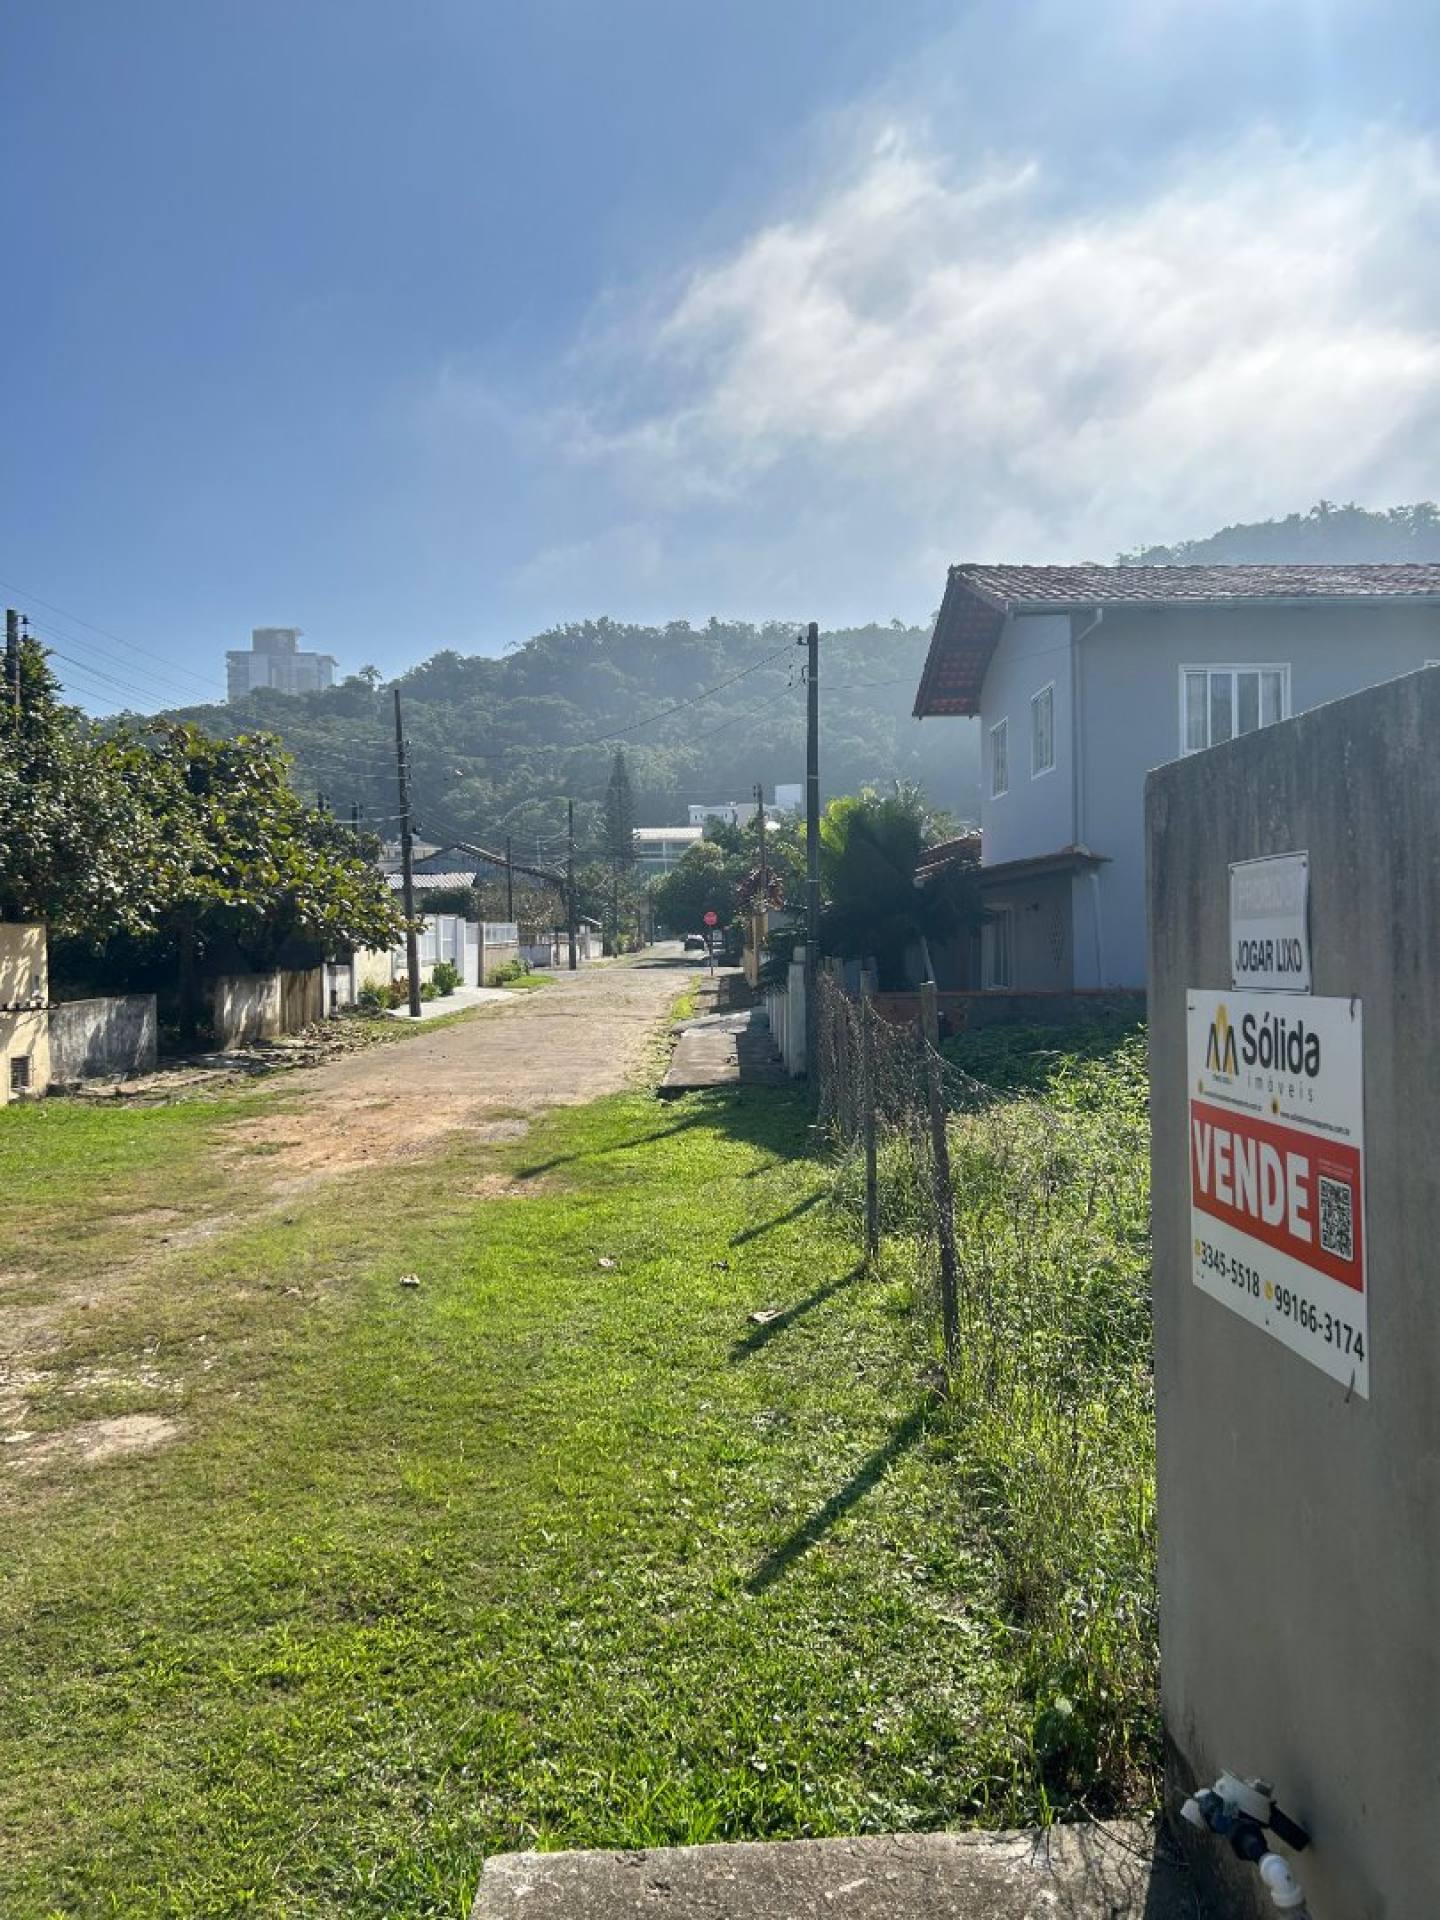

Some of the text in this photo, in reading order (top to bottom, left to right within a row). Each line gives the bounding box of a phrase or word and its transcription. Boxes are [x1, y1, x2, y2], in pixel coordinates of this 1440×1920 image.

[1236, 938, 1302, 973] JOGAR LIXO
[1242, 1011, 1320, 1078] Sólida
[1193, 1119, 1312, 1243] VENDE
[1201, 1241, 1364, 1362] 3345-5518 99166-3174
